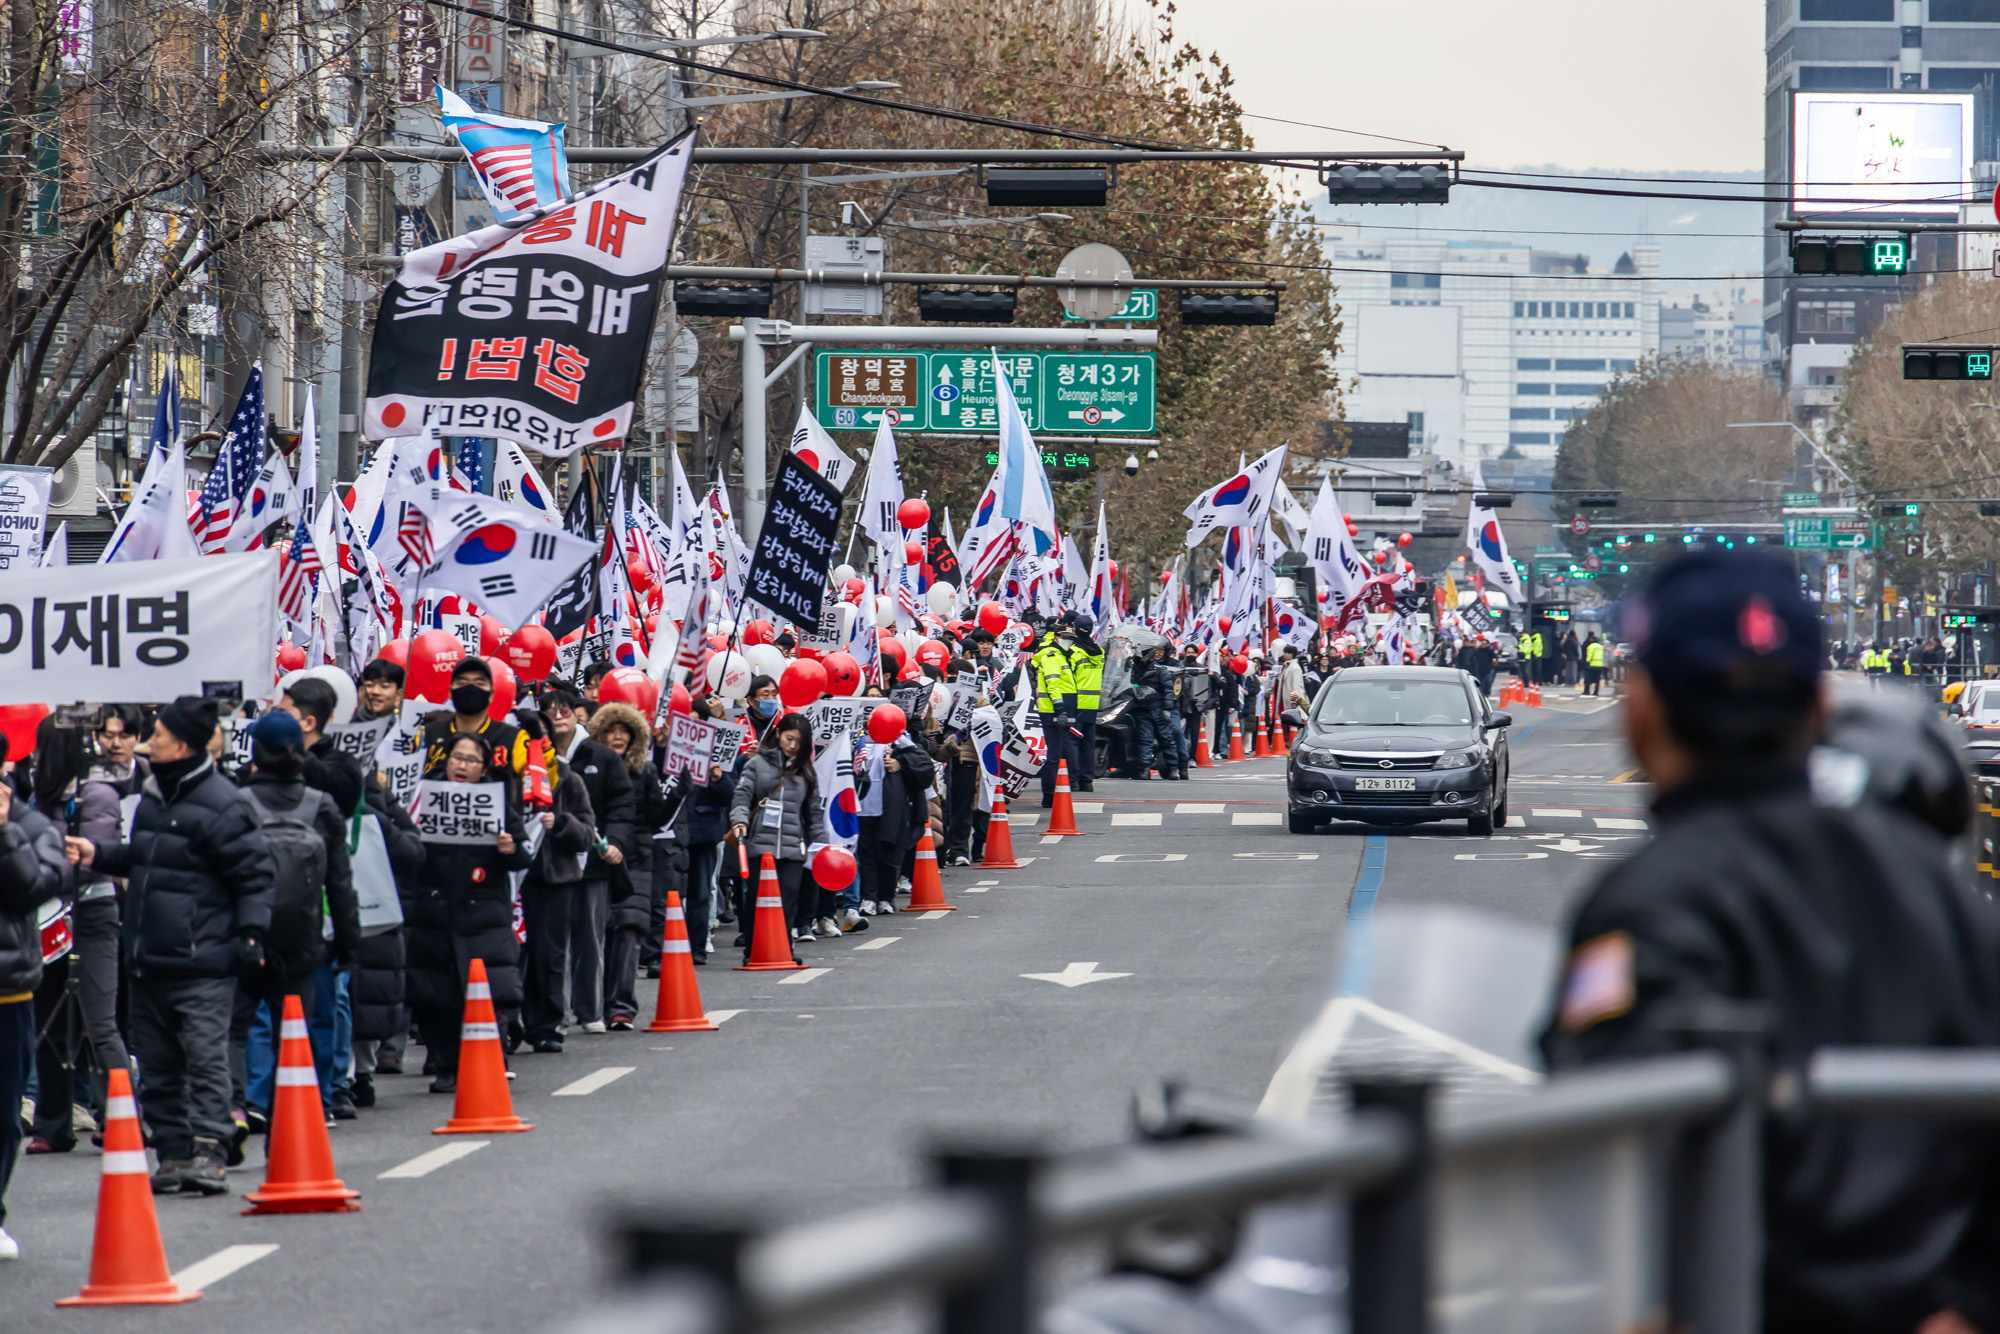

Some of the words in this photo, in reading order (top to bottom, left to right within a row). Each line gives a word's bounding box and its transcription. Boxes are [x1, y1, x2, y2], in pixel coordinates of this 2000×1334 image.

[840, 358, 907, 377] 창덕궁
[959, 357, 1034, 378] 흥인지문
[1057, 363, 1141, 385] 청계3가
[939, 386, 952, 399] 6
[961, 377, 1027, 394] 興仁門
[840, 392, 906, 406] Changdeokgung
[1057, 387, 1098, 405] Cheonggye
[1100, 388, 1139, 405] 3(sam)-ga
[838, 410, 853, 424] 50
[959, 407, 1034, 428] 종로가
[1063, 452, 1090, 467] 단속
[782, 466, 839, 521] 부정선거
[762, 534, 825, 587] 당당하게
[753, 567, 818, 622] 말하시오
[0, 591, 190, 670] 이재명
[435, 650, 459, 662] FREE
[432, 661, 457, 673] YOO
[676, 720, 708, 744] STOP
[680, 740, 696, 756] THE
[669, 751, 704, 779] STEAL
[1361, 779, 1380, 789] 12누
[1384, 779, 1410, 789] 8112
[429, 791, 494, 818] 계엄은
[418, 813, 504, 838] 정당했다
